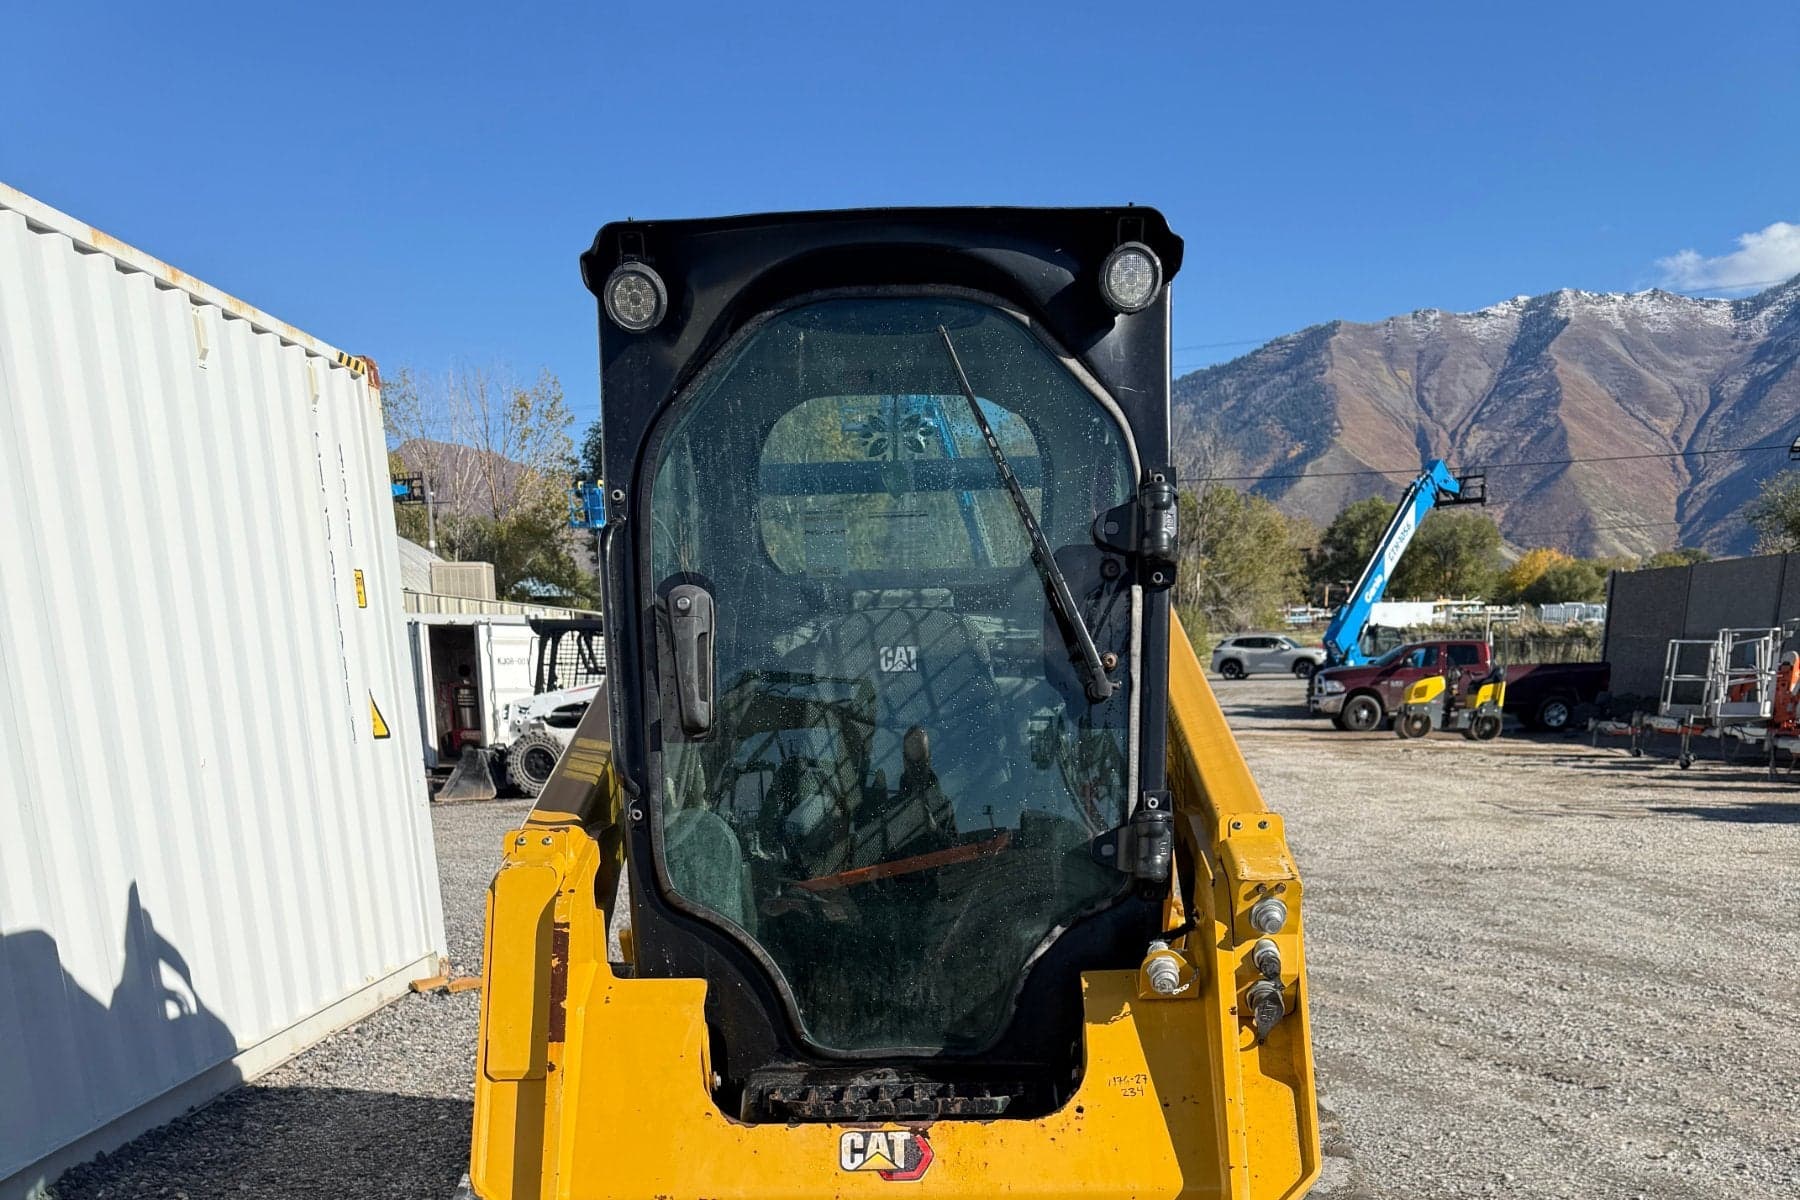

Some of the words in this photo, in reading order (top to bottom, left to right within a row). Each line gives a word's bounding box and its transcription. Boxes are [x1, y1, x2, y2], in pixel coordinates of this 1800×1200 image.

[880, 646, 919, 672] CAT
[1121, 1085, 1144, 1096] 234
[841, 1131, 911, 1171] CAT
